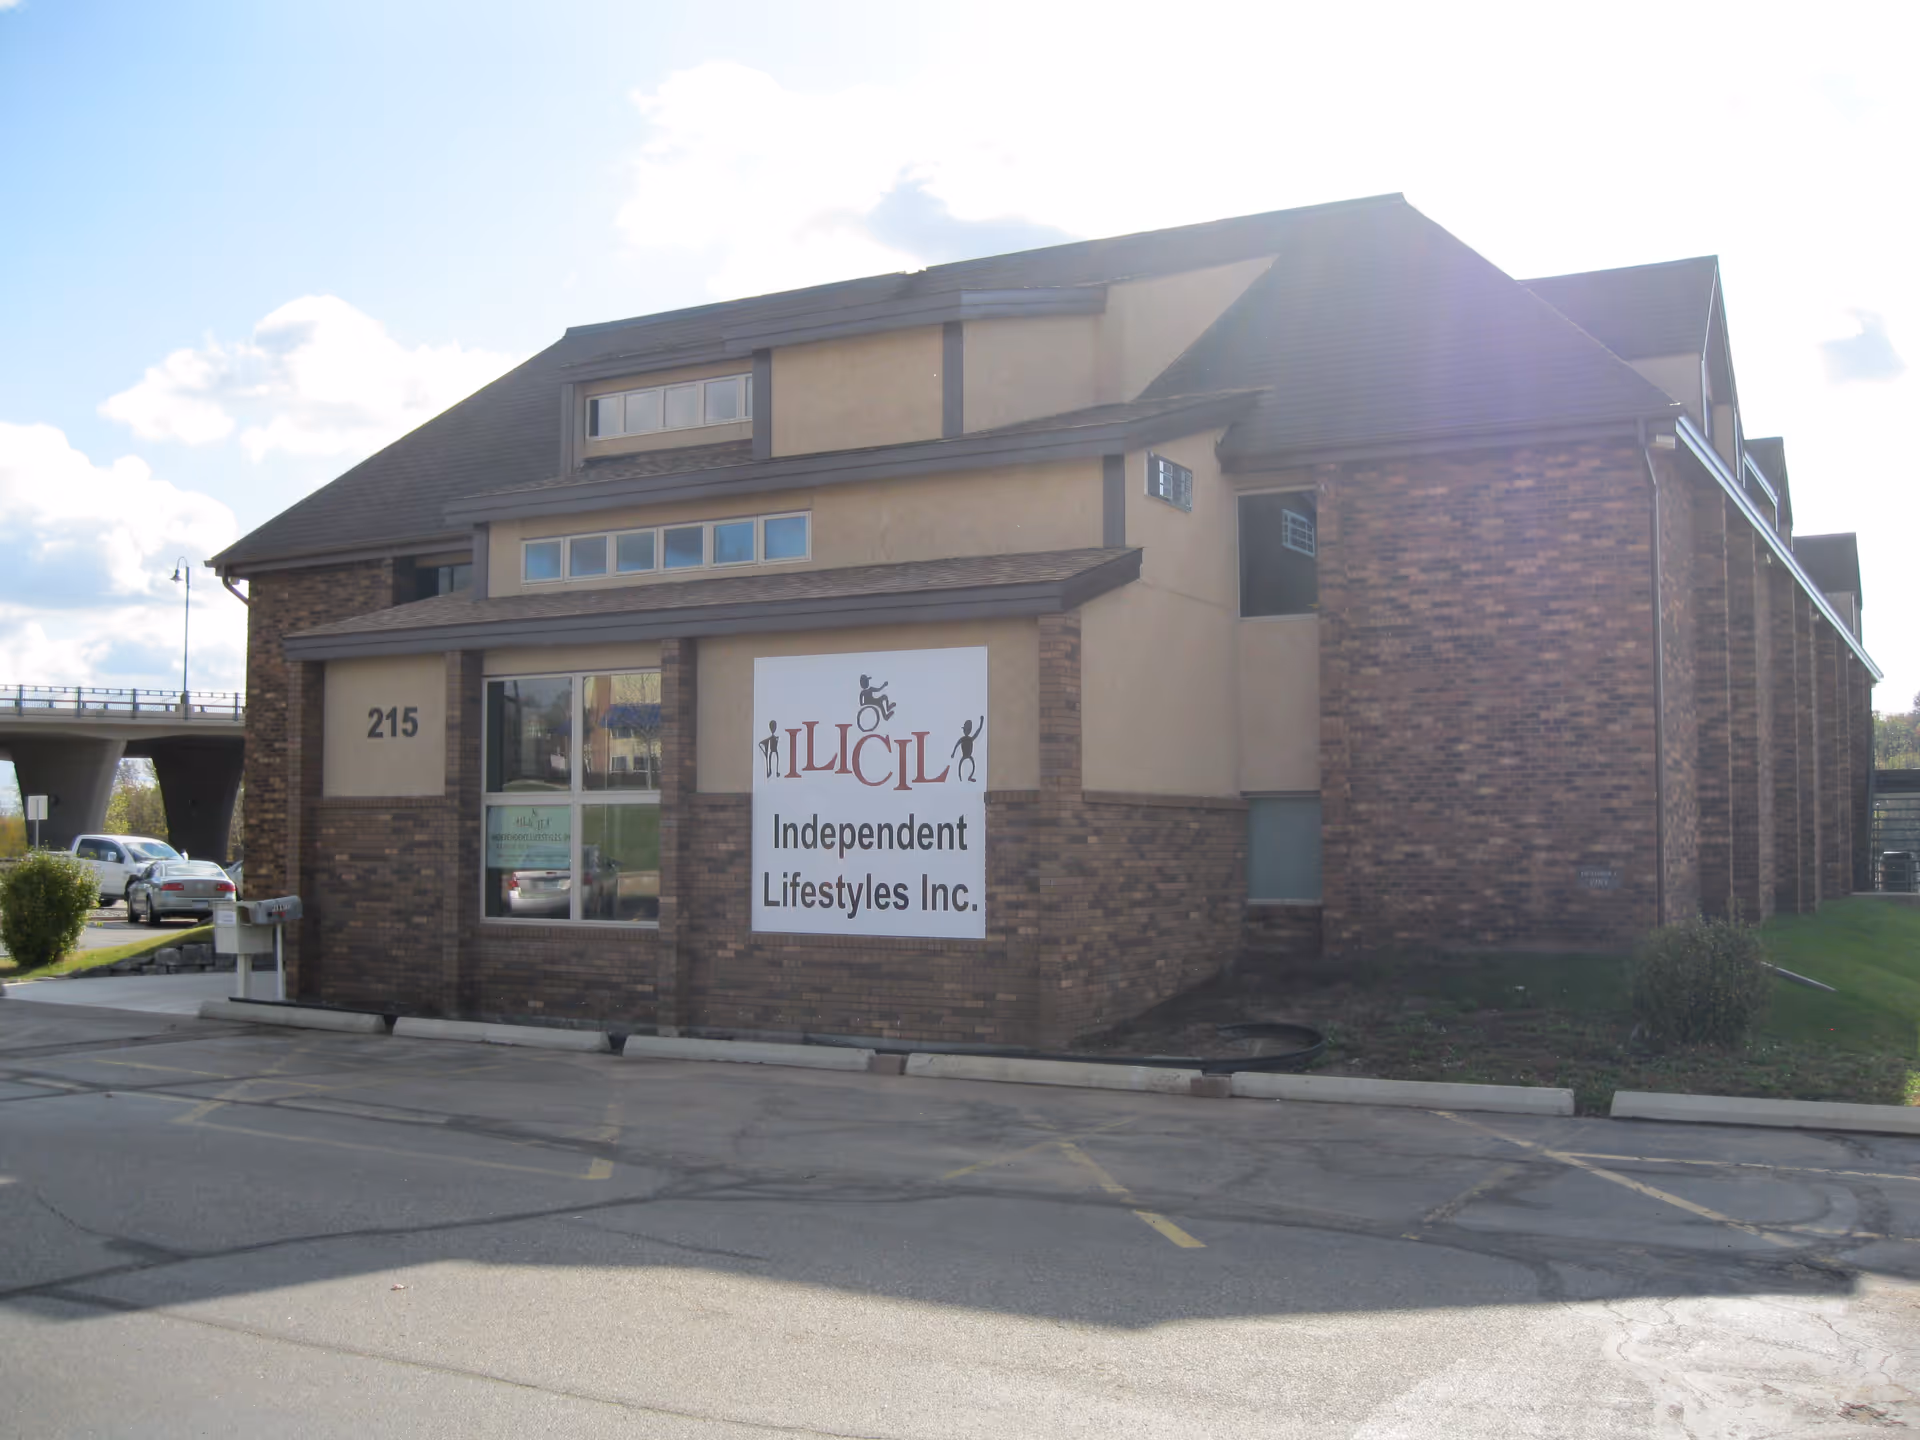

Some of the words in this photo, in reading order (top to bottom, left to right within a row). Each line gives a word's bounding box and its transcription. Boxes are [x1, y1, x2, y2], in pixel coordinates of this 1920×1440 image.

[367, 706, 418, 738] 215
[784, 721, 950, 790] ILICIL
[774, 813, 968, 859] Independent
[763, 872, 910, 919] Lifestyles
[921, 874, 978, 912] Inc.
